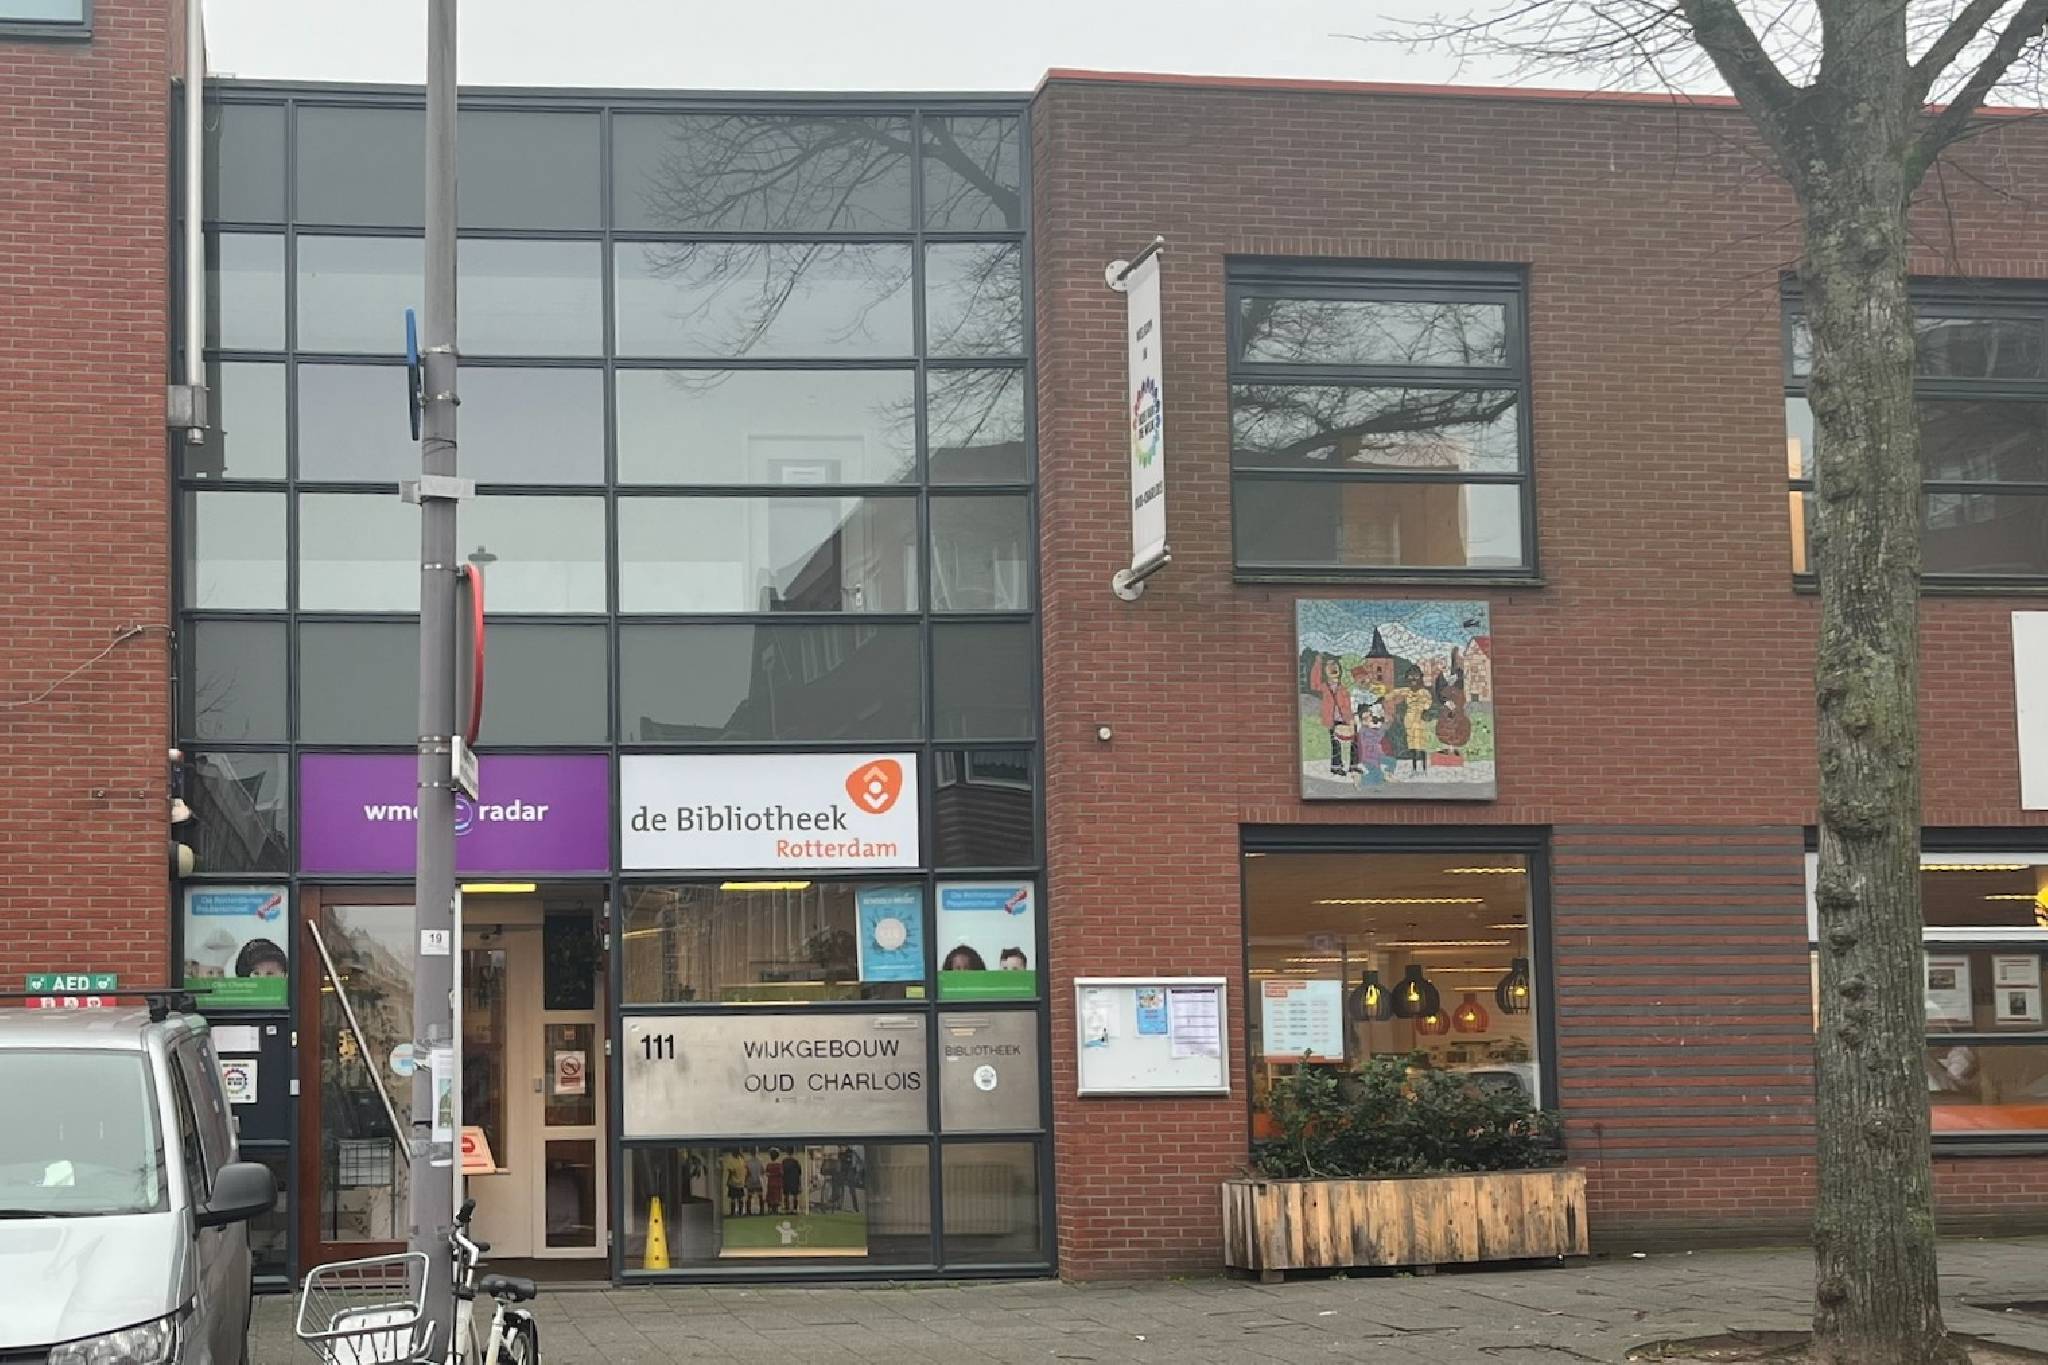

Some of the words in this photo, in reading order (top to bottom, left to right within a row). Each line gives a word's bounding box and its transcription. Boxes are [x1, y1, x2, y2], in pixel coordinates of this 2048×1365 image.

[478, 799, 549, 822] radar
[631, 806, 667, 832] de
[677, 804, 848, 832] Bibliotheek
[776, 837, 897, 858] Rotterdam
[429, 933, 442, 944] 19
[52, 976, 89, 991] AED
[640, 1034, 675, 1060] 111
[743, 1039, 900, 1059] WIJKGEBOUW
[945, 1044, 1021, 1056] BIBLIOTHEEK
[744, 1072, 795, 1092] OUD
[808, 1071, 921, 1091] CHARLOIS
